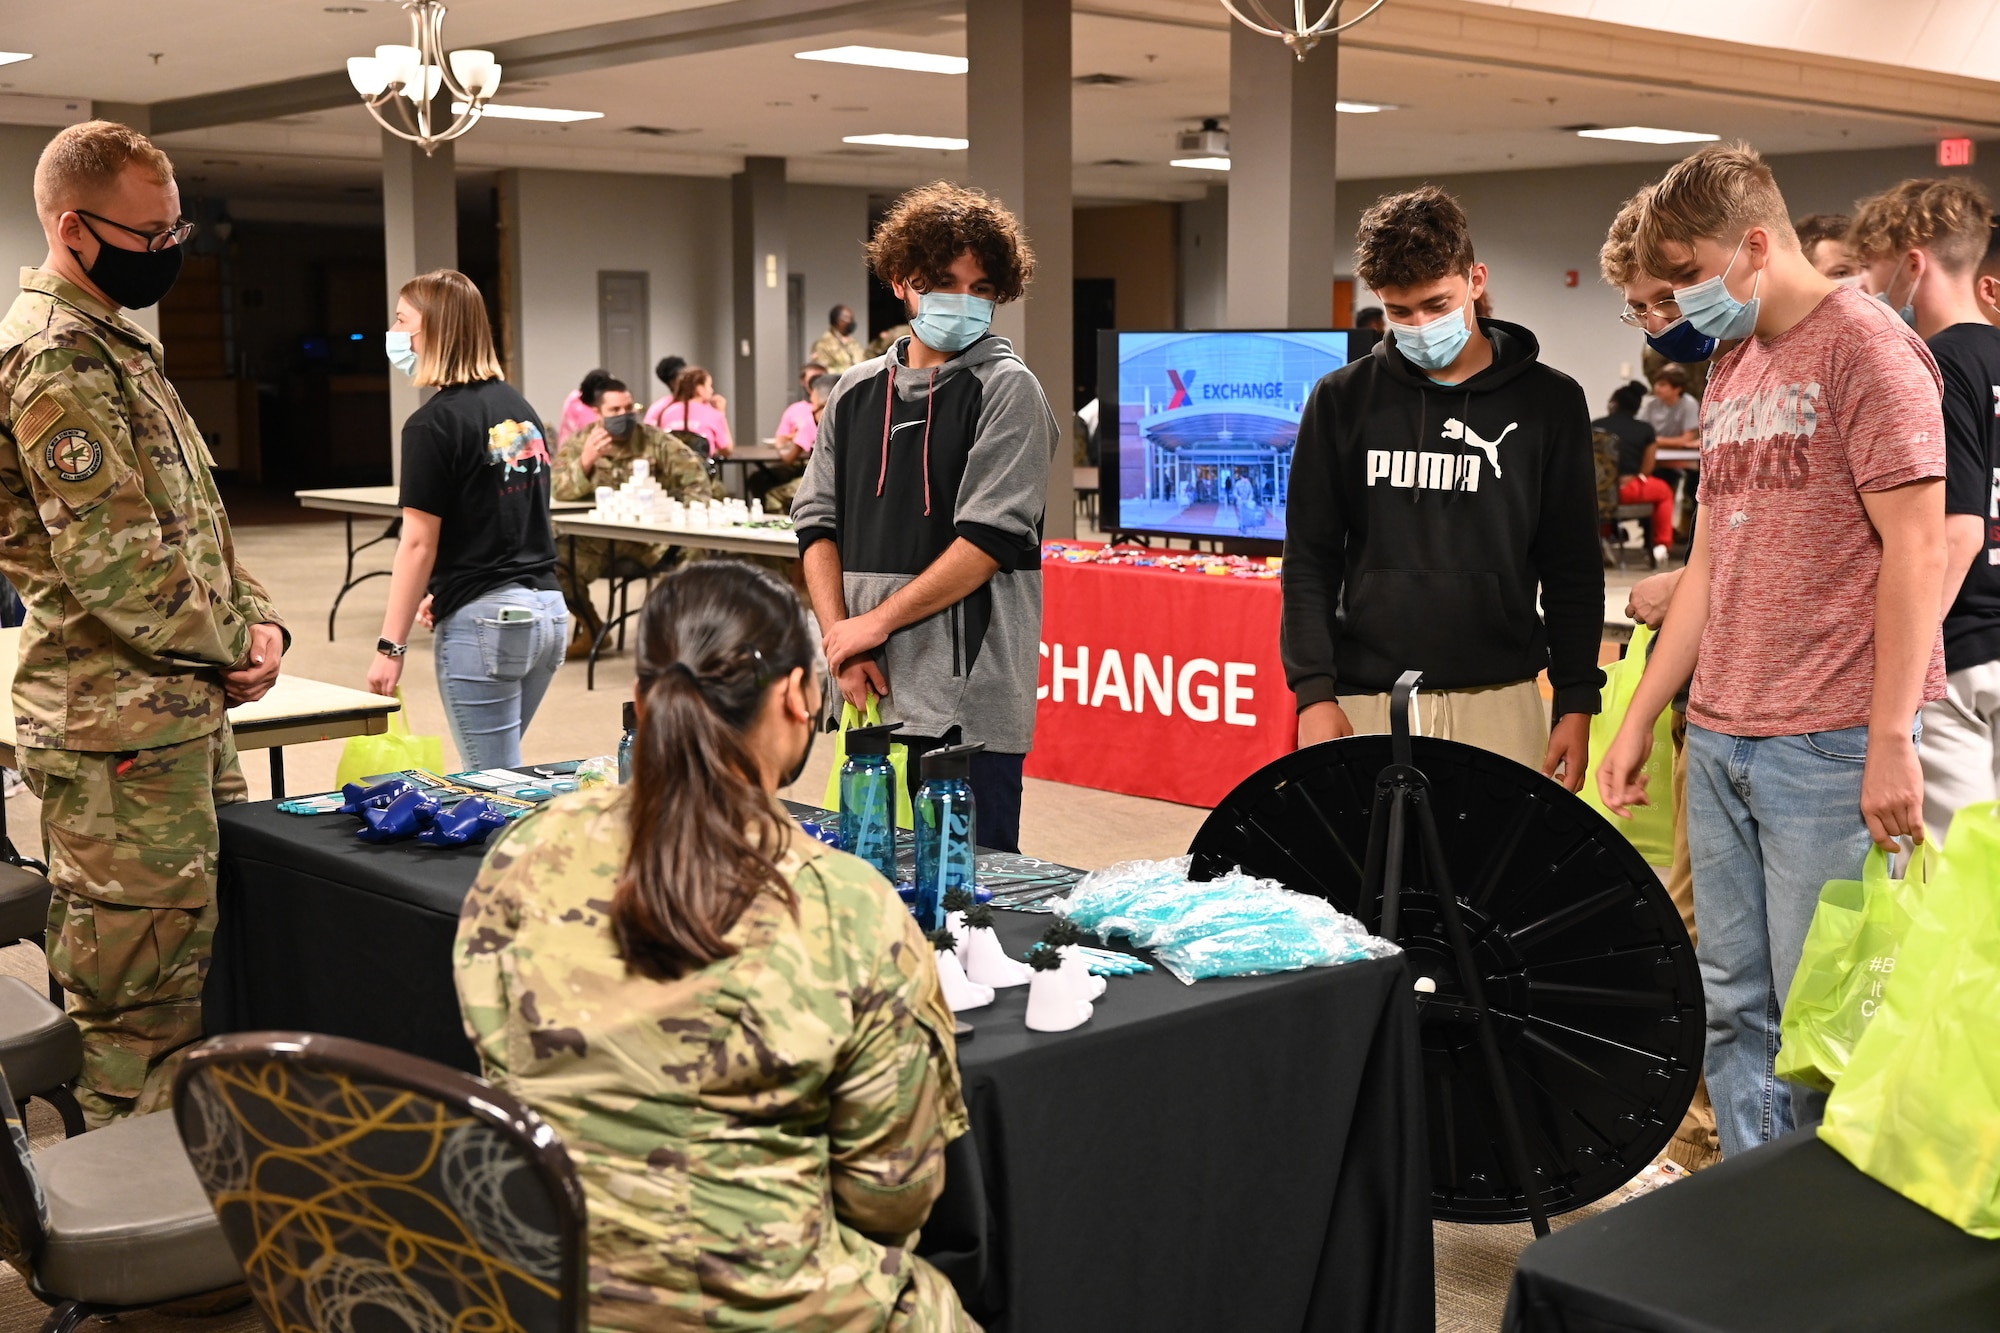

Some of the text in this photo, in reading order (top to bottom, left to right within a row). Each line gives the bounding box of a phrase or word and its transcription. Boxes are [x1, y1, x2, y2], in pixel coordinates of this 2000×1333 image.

[1940, 139, 1972, 166] EXIT
[1203, 382, 1283, 400] EXCHANGE
[1366, 449, 1482, 492] PUMA
